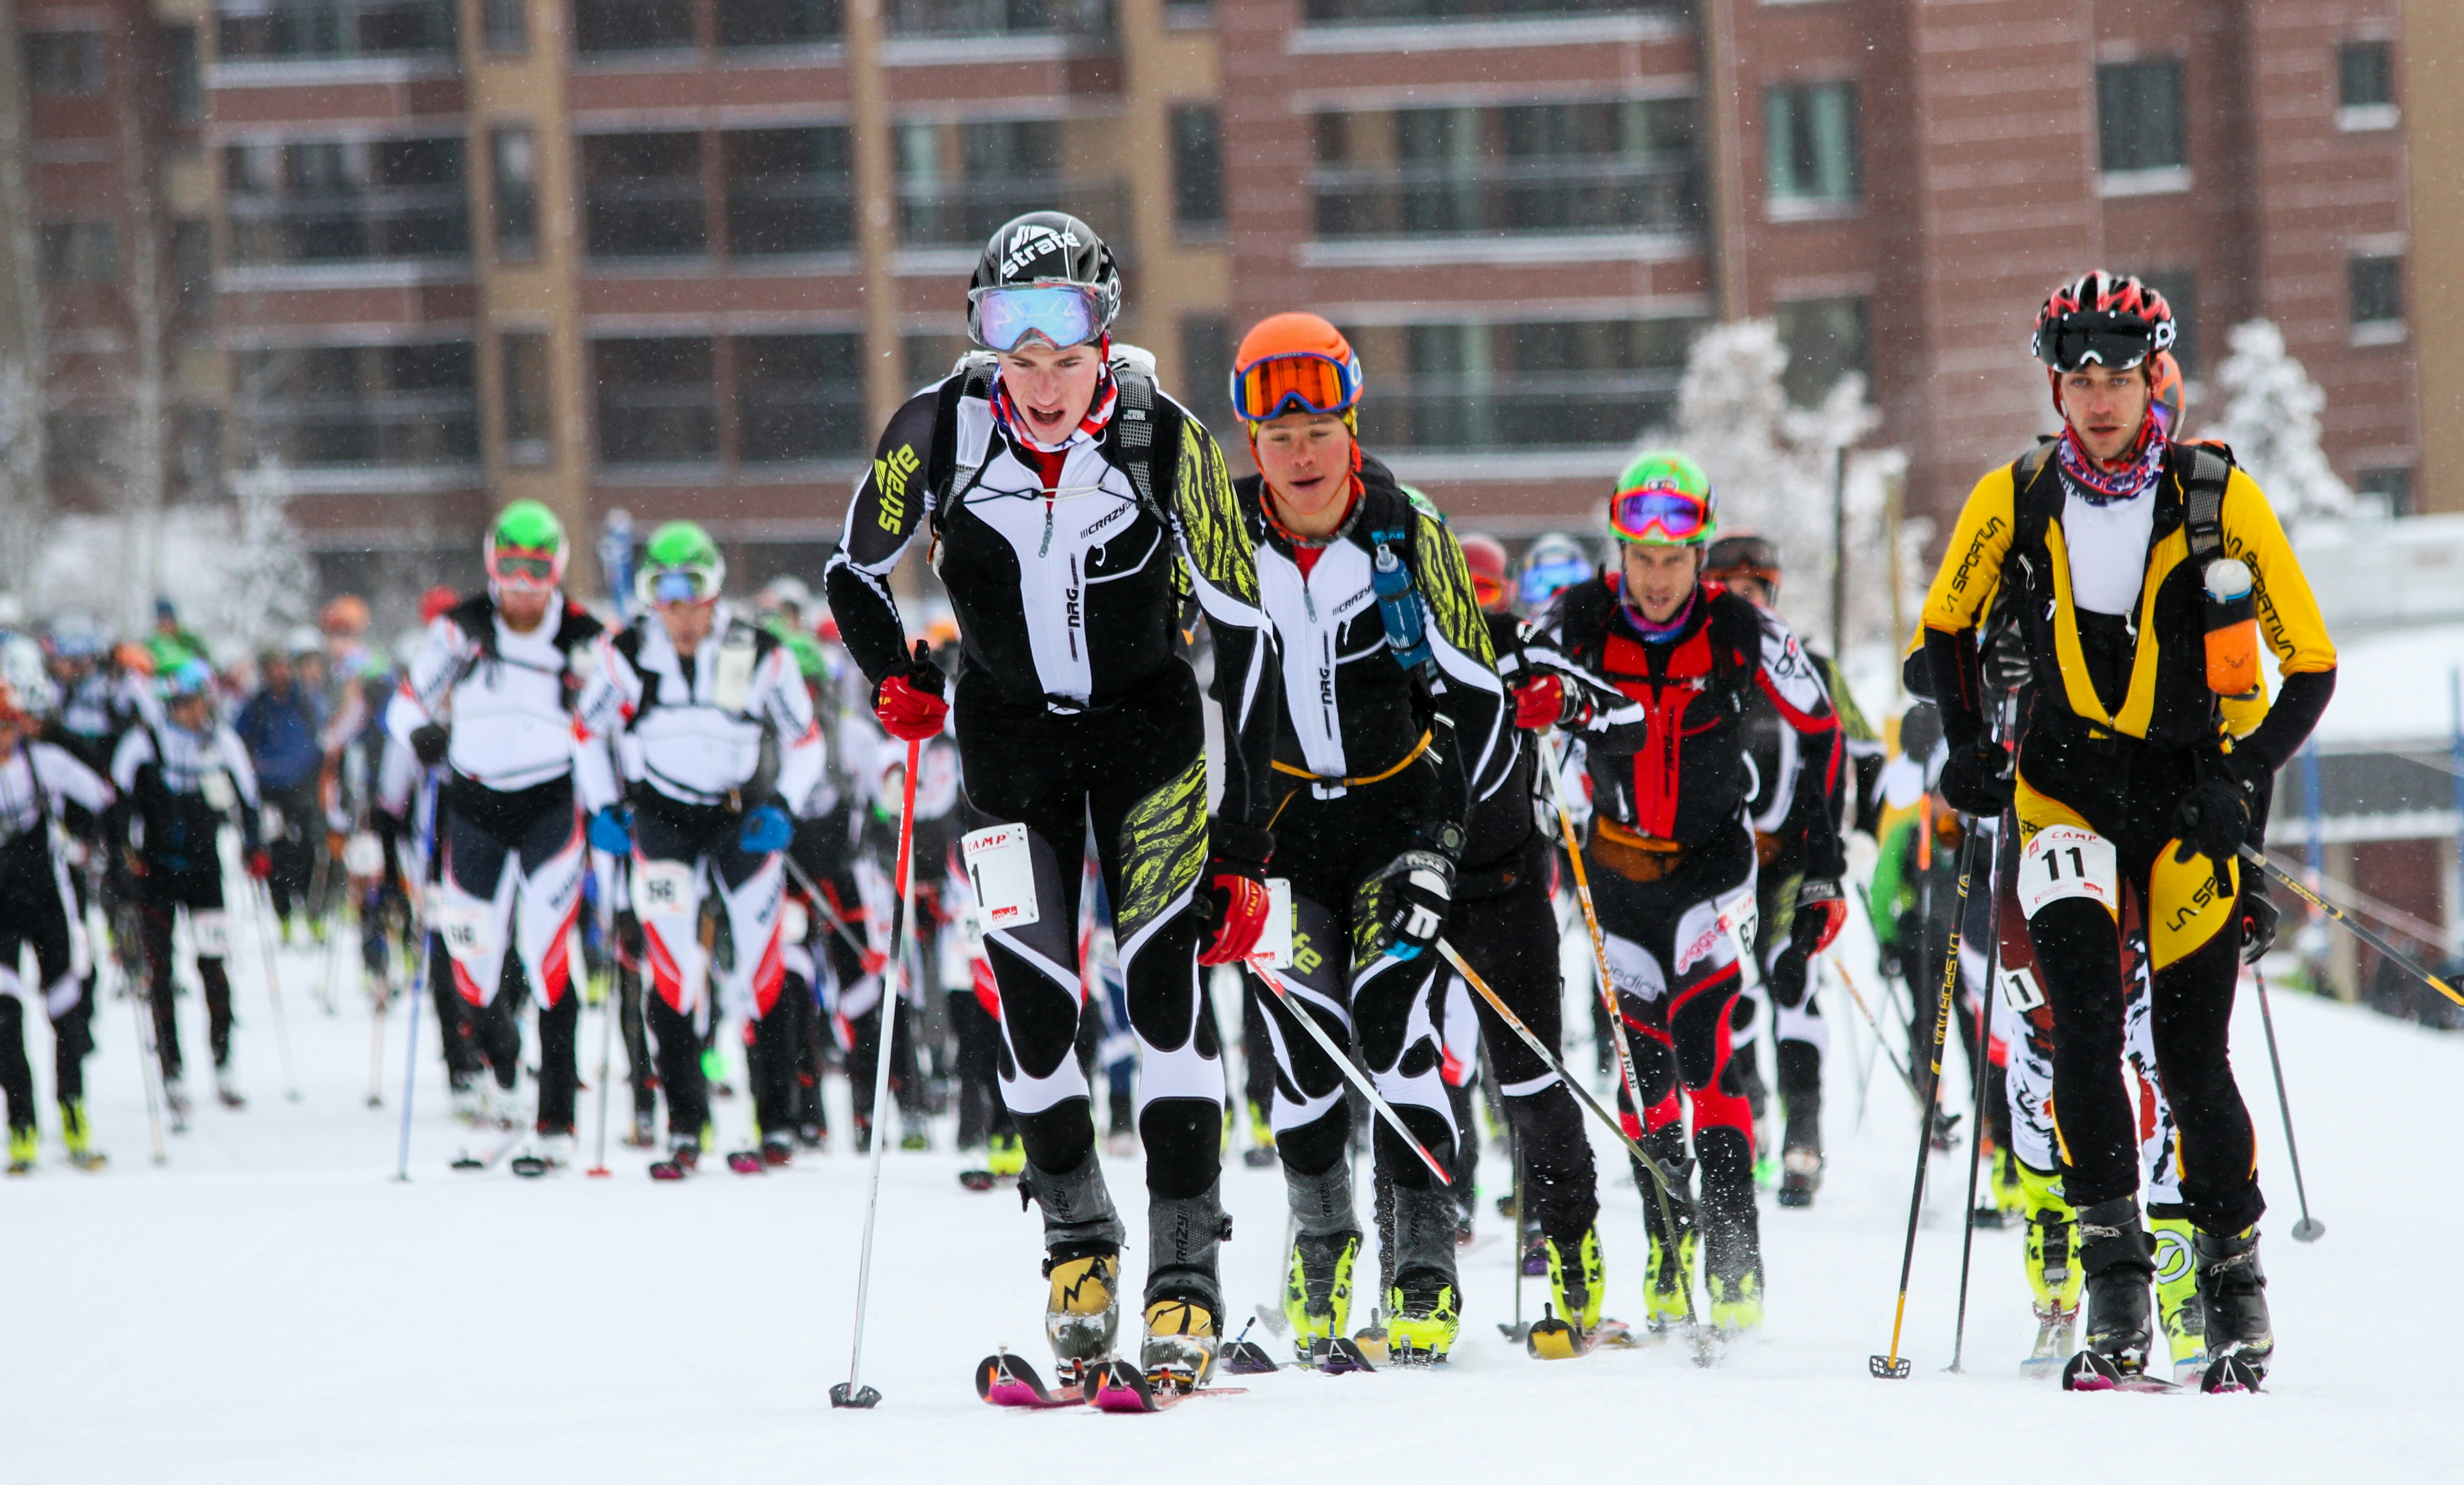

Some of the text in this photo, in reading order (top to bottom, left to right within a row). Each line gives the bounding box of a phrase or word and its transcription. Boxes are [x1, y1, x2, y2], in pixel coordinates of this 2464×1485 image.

[1002, 231, 1081, 279] strafe
[878, 443, 921, 535] strafe
[1088, 503, 1126, 535] CRAZY
[1942, 516, 2006, 613] LA SPORTIVA
[2245, 550, 2296, 661] SPORTIVA
[968, 834, 1007, 852] CAMP
[2052, 831, 2098, 842] CAMP
[2041, 847, 2085, 882] 11
[971, 862, 984, 908] 1
[2166, 907, 2197, 932] LA
[1623, 1052, 1638, 1089] TRAB
